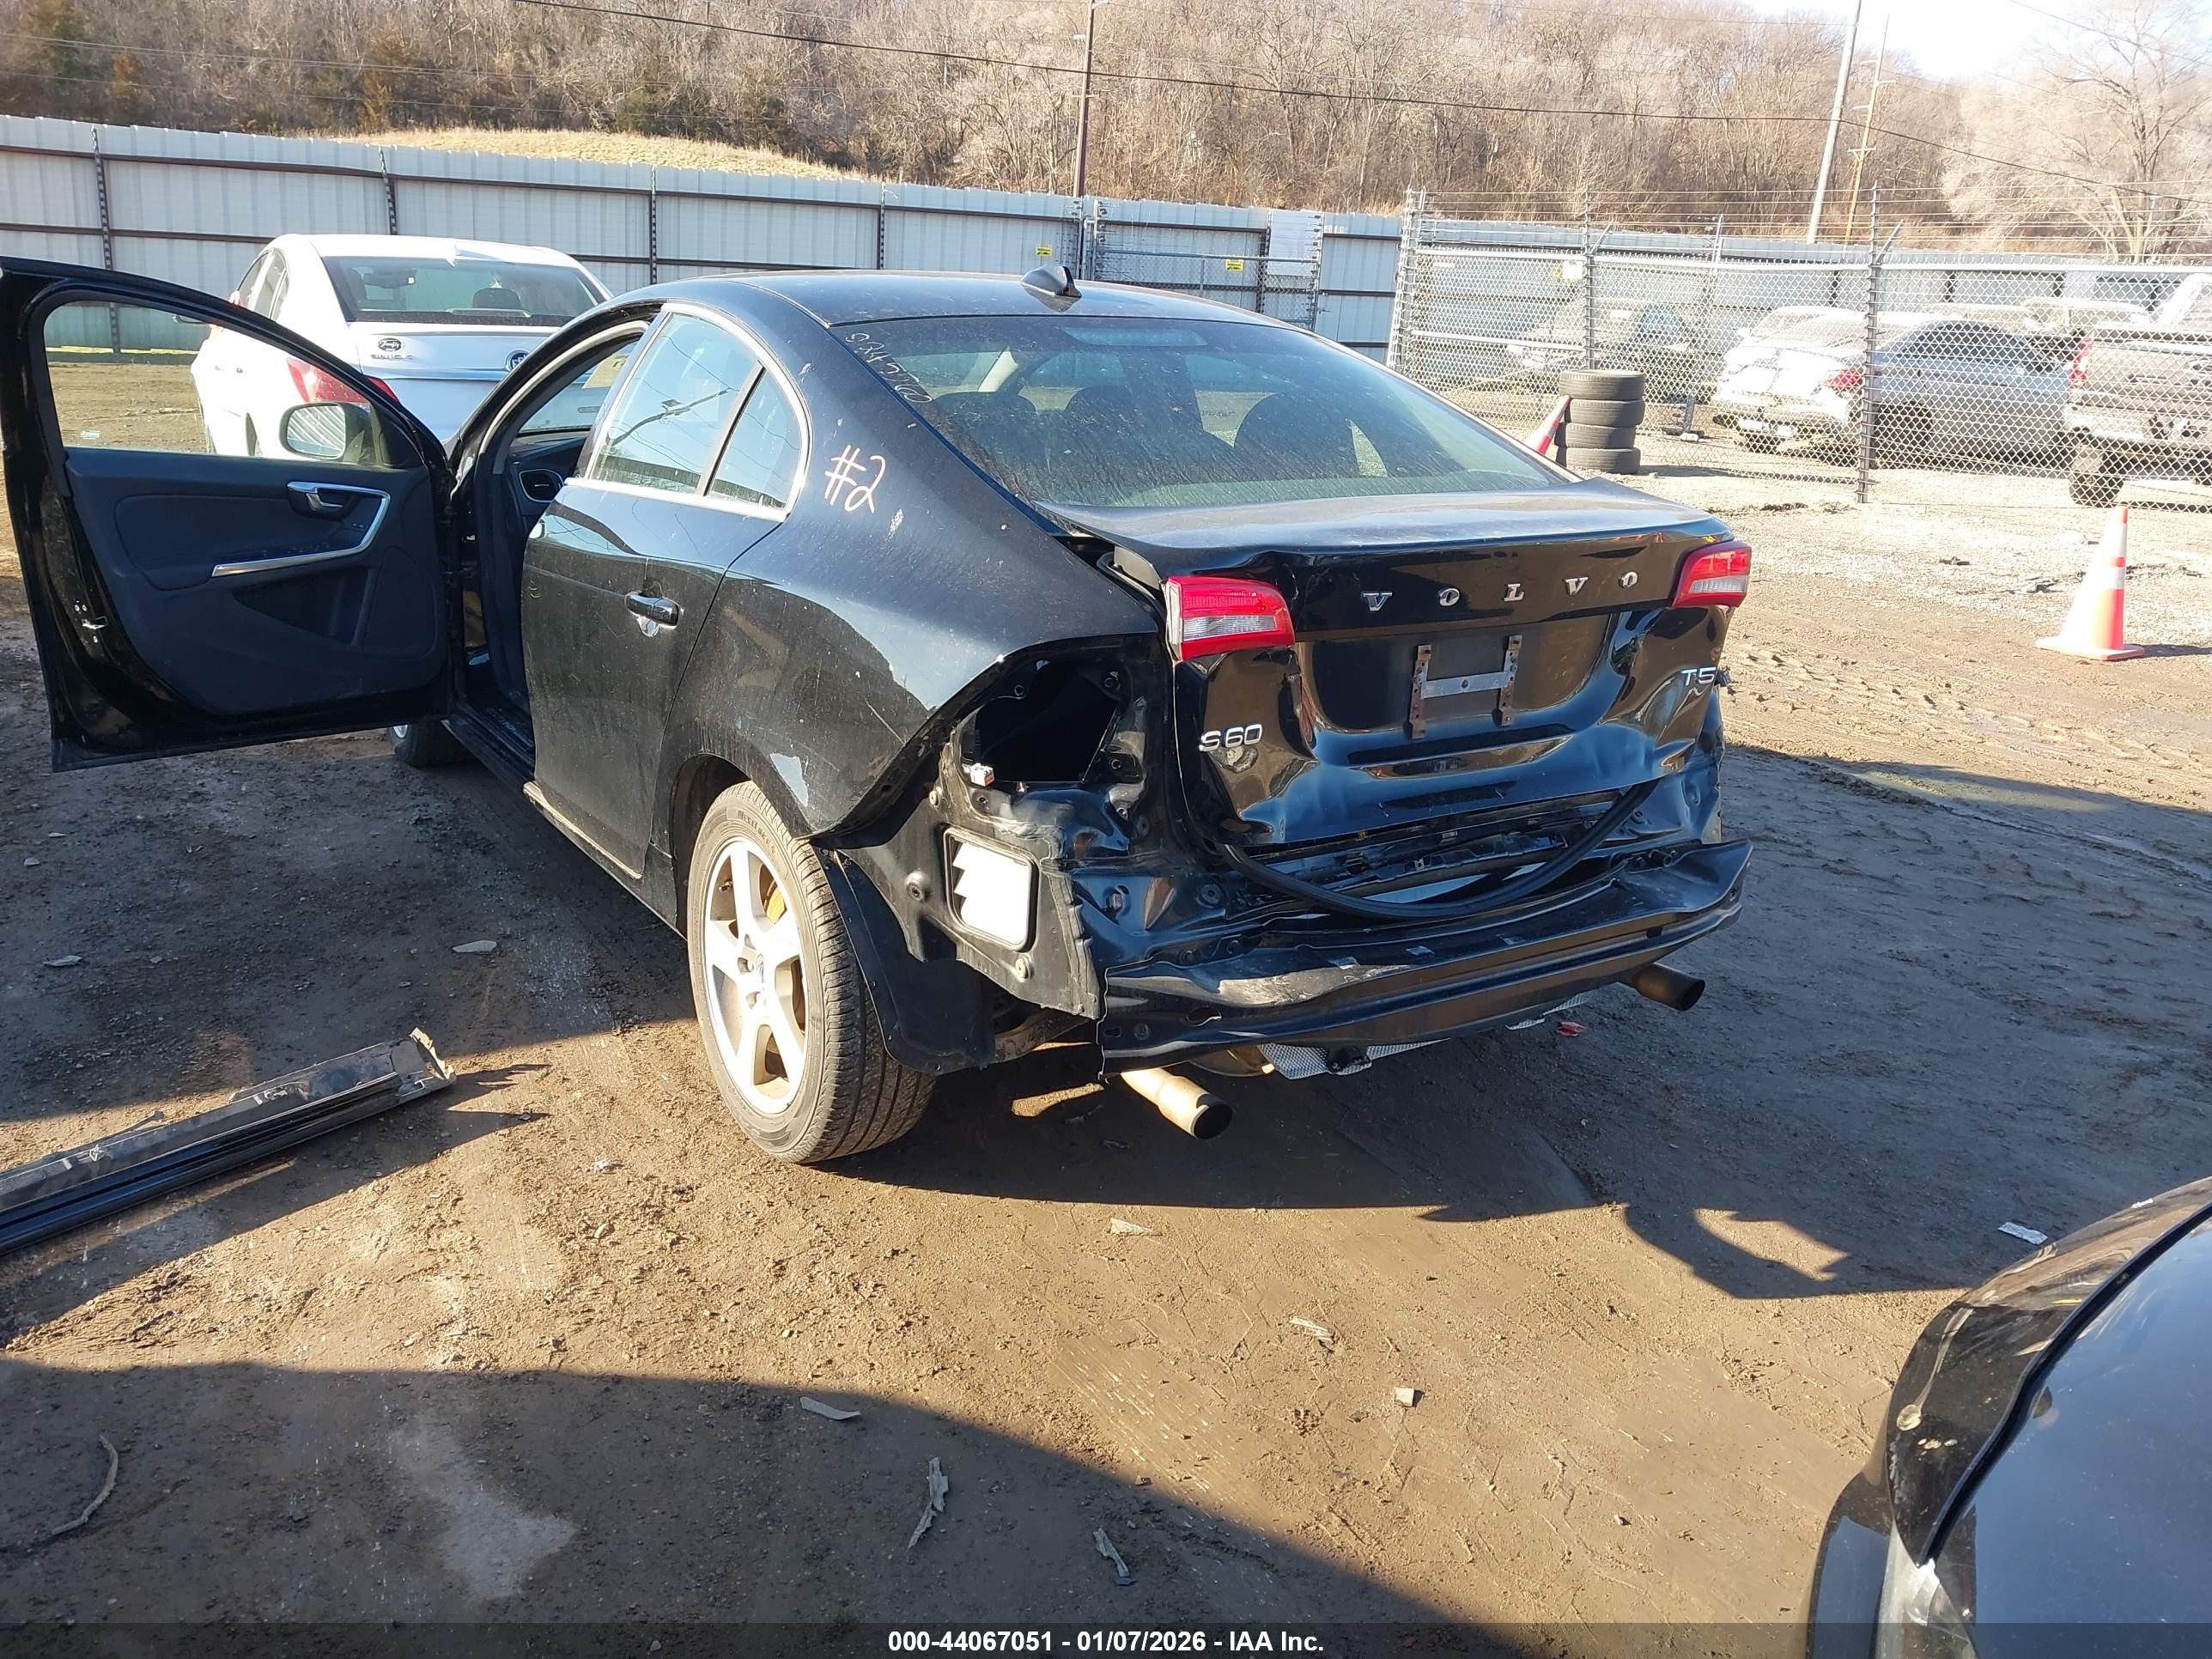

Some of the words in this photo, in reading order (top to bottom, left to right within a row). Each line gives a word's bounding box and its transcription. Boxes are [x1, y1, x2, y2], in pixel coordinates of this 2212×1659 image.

[824, 444, 886, 514] #2
[1362, 571, 1638, 612] VOLVO
[1680, 666, 1717, 686] T5
[1199, 724, 1262, 751] S60
